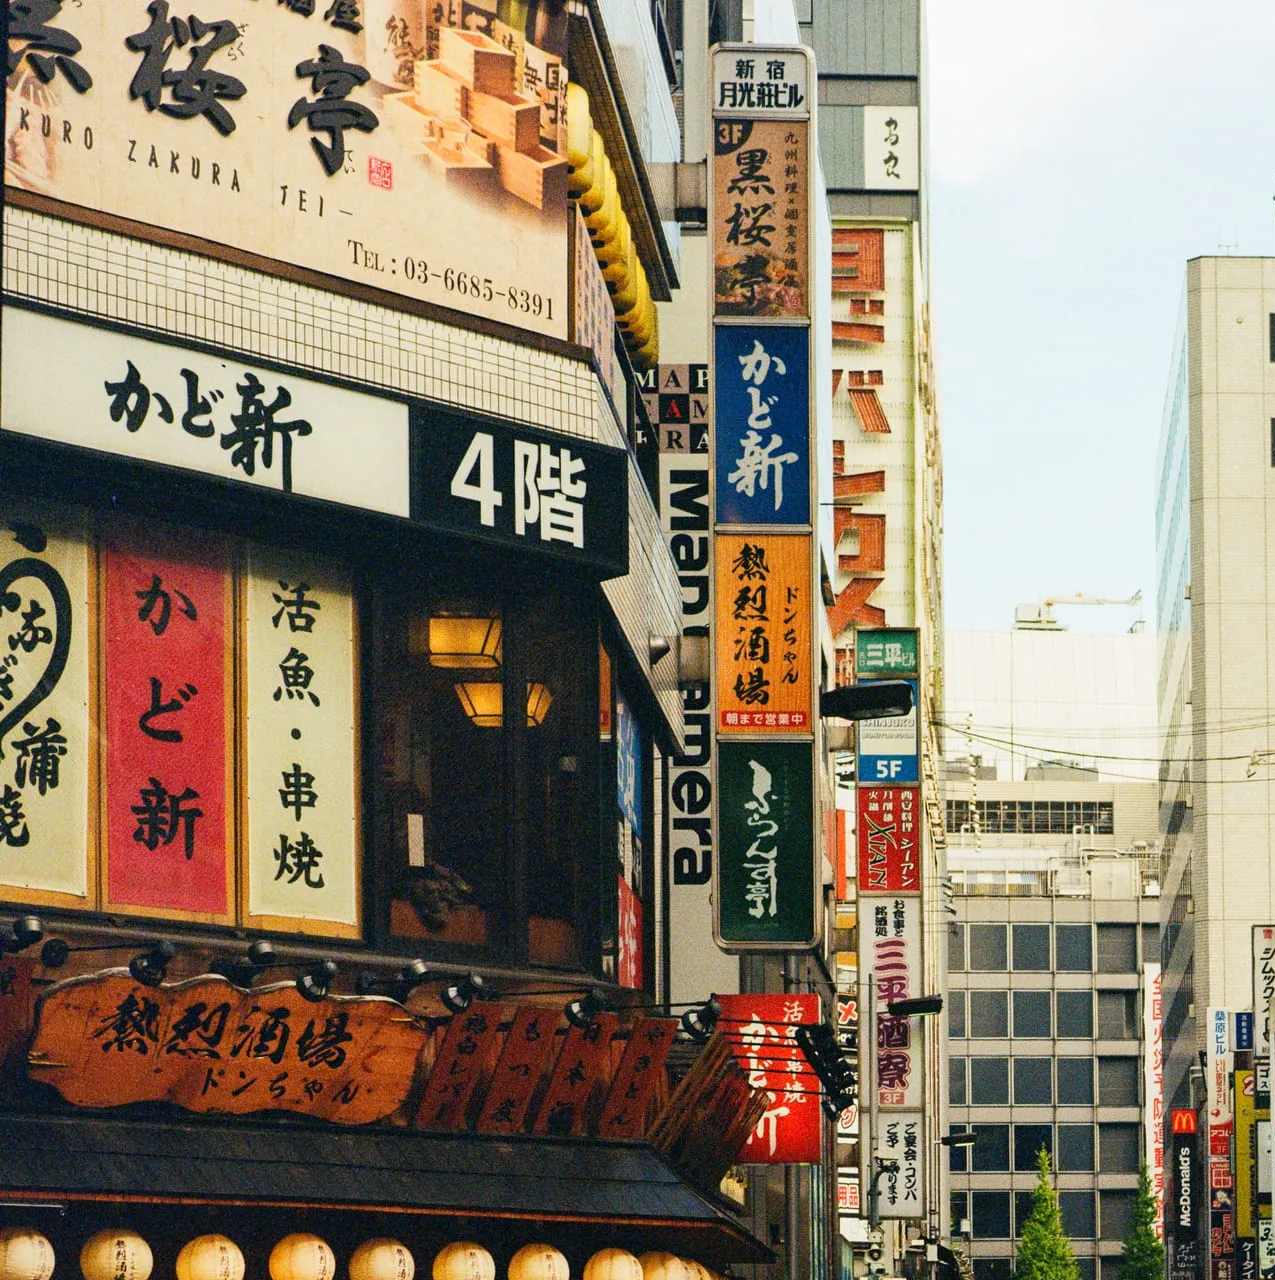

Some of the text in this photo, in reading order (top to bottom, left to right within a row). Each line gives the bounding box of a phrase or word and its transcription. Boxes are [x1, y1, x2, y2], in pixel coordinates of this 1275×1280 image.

[736, 59, 785, 80] 新宿
[20, 107, 325, 218] KURO ZAKURA TEI
[718, 124, 744, 145] 3F
[404, 254, 556, 322] 03-6685-8391
[104, 359, 313, 493] かど新
[727, 340, 799, 511] かど新
[450, 432, 588, 548] 4階
[732, 543, 770, 705] 熱烈酒場
[781, 587, 800, 685] ドンちゃん
[131, 573, 204, 860] かど新
[272, 579, 325, 888] 活魚・串焼
[726, 712, 803, 726] 朝まで営業中
[877, 760, 902, 778] 5F
[93, 997, 354, 1070] 熱烈酒場
[200, 1066, 374, 1105] ドンちゃん
[884, 1093, 901, 1104] 3F
[1179, 1147, 1191, 1227] McDonald's
